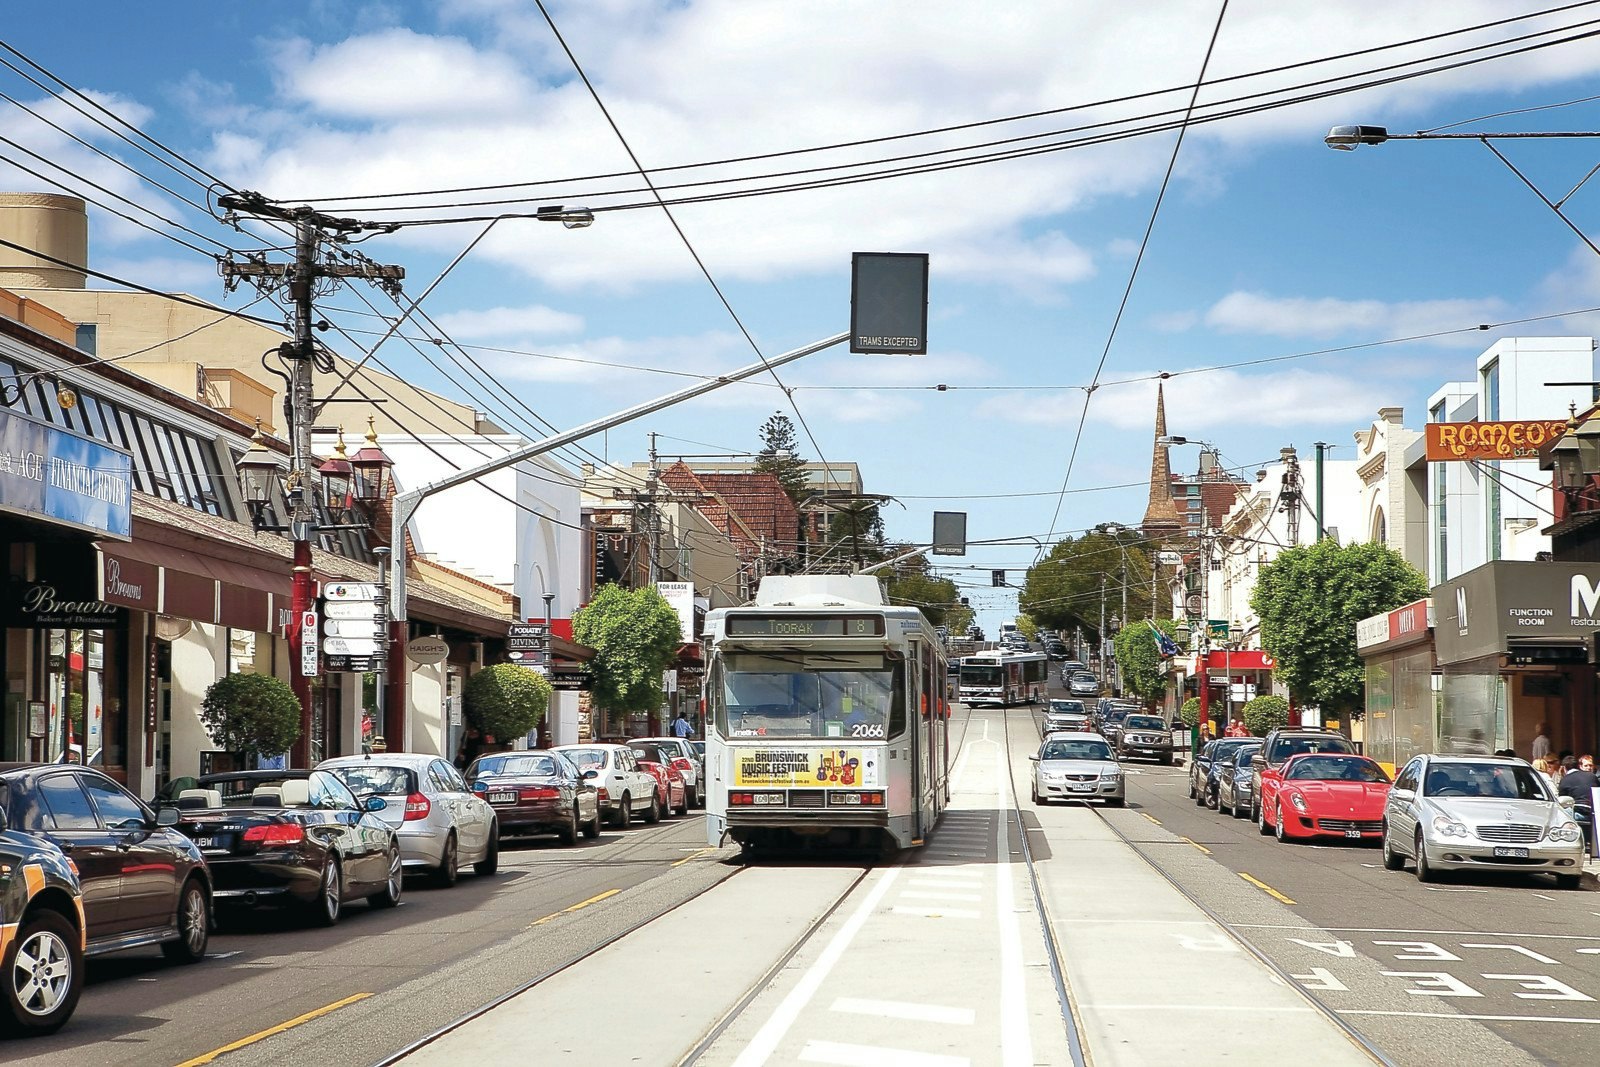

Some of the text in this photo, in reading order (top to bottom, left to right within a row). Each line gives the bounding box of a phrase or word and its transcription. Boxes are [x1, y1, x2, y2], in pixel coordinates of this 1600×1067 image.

[859, 336, 918, 346] TRAMS EXCEPTED
[1438, 422, 1567, 456] ROMEO'S
[17, 450, 44, 482] AGE
[51, 457, 128, 507] FINANCIAL REVIEW
[596, 533, 604, 577] PITARD
[107, 558, 142, 600] Browns
[22, 585, 118, 613] Browns
[1571, 574, 1600, 617] M
[1509, 608, 1553, 616] FUNCTION
[856, 619, 865, 633] 8
[306, 647, 315, 655] 1P
[851, 724, 884, 738] 2066
[741, 763, 810, 773] MUSIC FESTIVAL
[755, 753, 809, 763] BRUNSWICK
